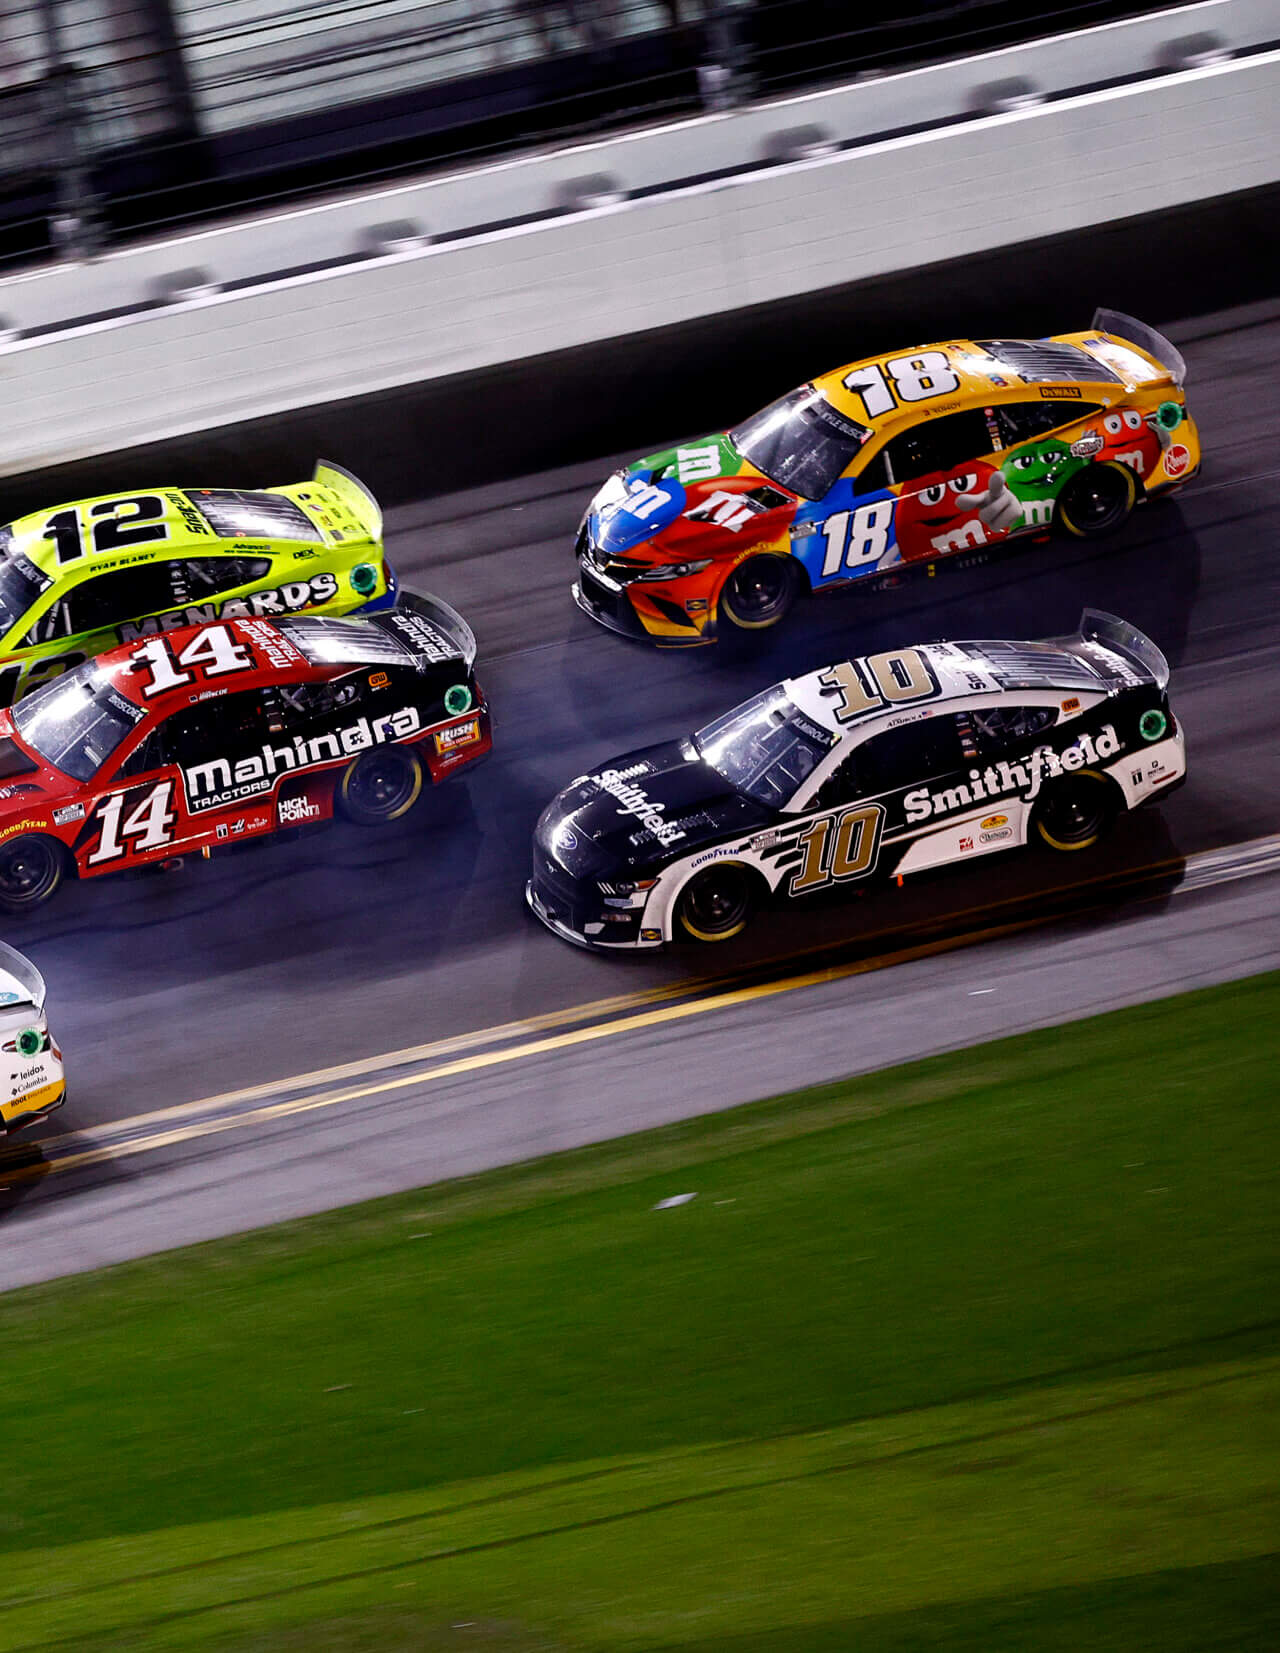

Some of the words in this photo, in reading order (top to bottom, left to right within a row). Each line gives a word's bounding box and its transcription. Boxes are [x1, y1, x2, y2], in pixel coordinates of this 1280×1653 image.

[842, 352, 959, 420] 18
[838, 420, 864, 439] BUSC
[42, 495, 169, 566] 12
[822, 501, 894, 577] 18
[930, 519, 988, 555] m
[90, 560, 117, 573] RYAN
[119, 552, 157, 566] BLANEY
[116, 572, 339, 646] MENARDS
[132, 624, 254, 698] 14
[820, 649, 940, 723] 10
[439, 722, 475, 742] RUSH
[791, 717, 831, 745] ALMIROLA
[185, 706, 420, 798] Mahindra
[903, 724, 1121, 825] Smithfield
[193, 779, 271, 809] TRACTORS
[277, 796, 307, 812] HIGH
[88, 781, 174, 866] 14
[279, 805, 316, 824] POINT
[691, 849, 740, 868] GOODYEAR
[791, 804, 885, 895] 10
[17, 1075, 49, 1093] Columbia
[19, 1064, 46, 1081] leidos
